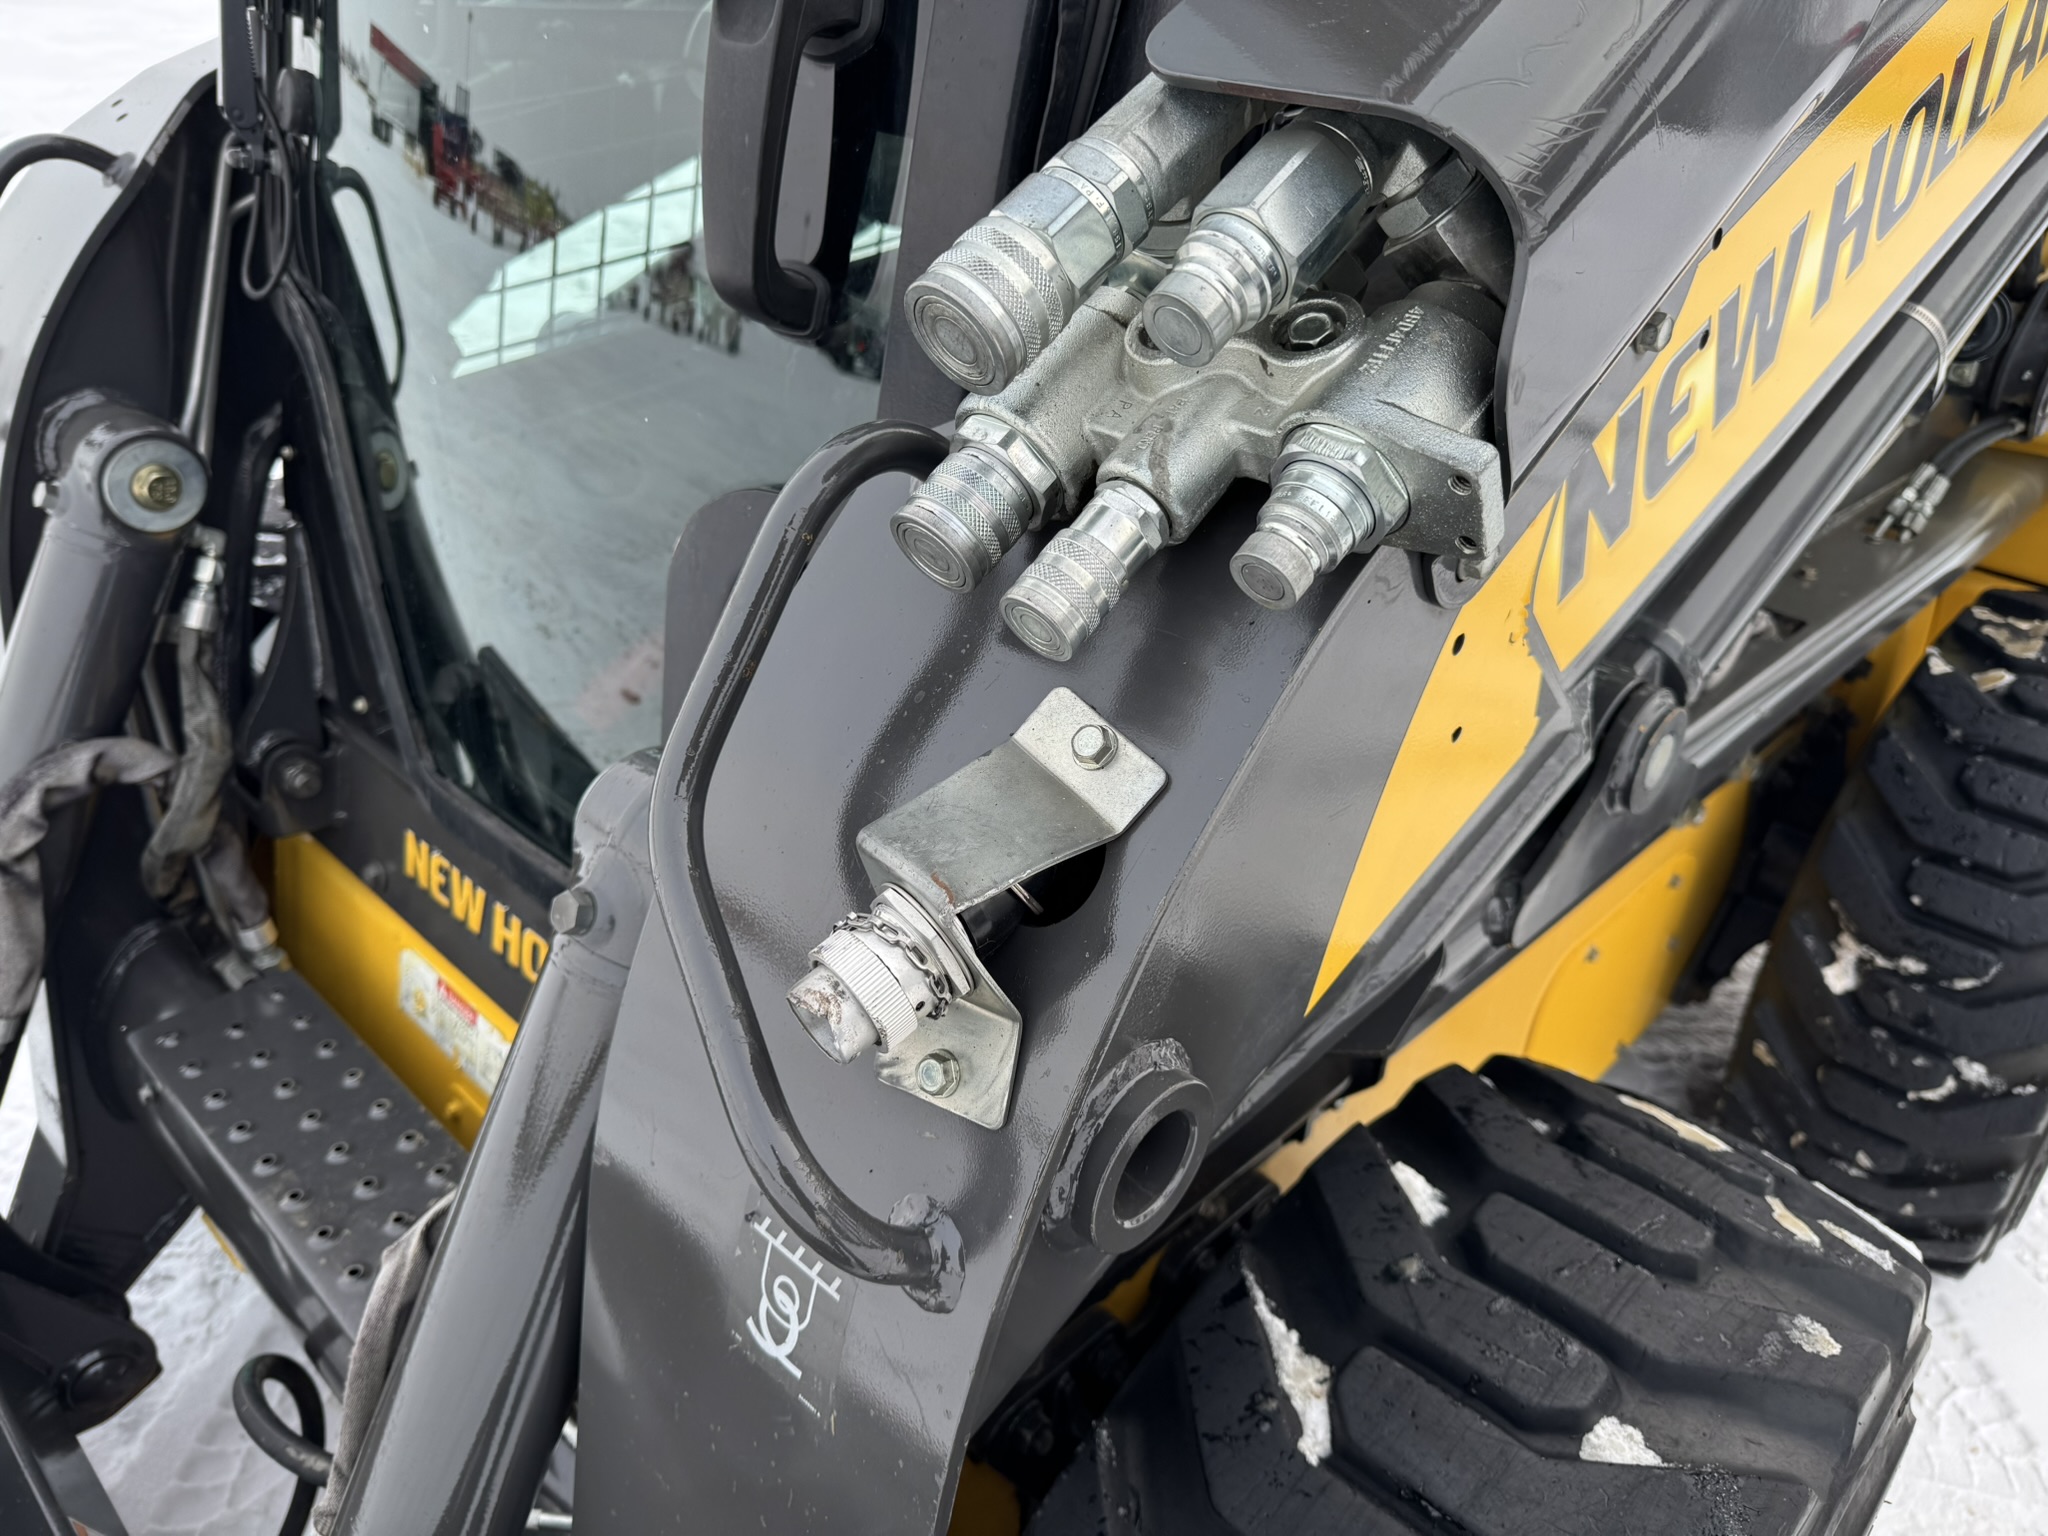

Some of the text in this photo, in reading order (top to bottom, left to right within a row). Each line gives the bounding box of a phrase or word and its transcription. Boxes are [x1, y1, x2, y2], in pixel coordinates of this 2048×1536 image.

[1556, 0, 2048, 606] NEW HOLLA
[402, 828, 487, 935] NEW
